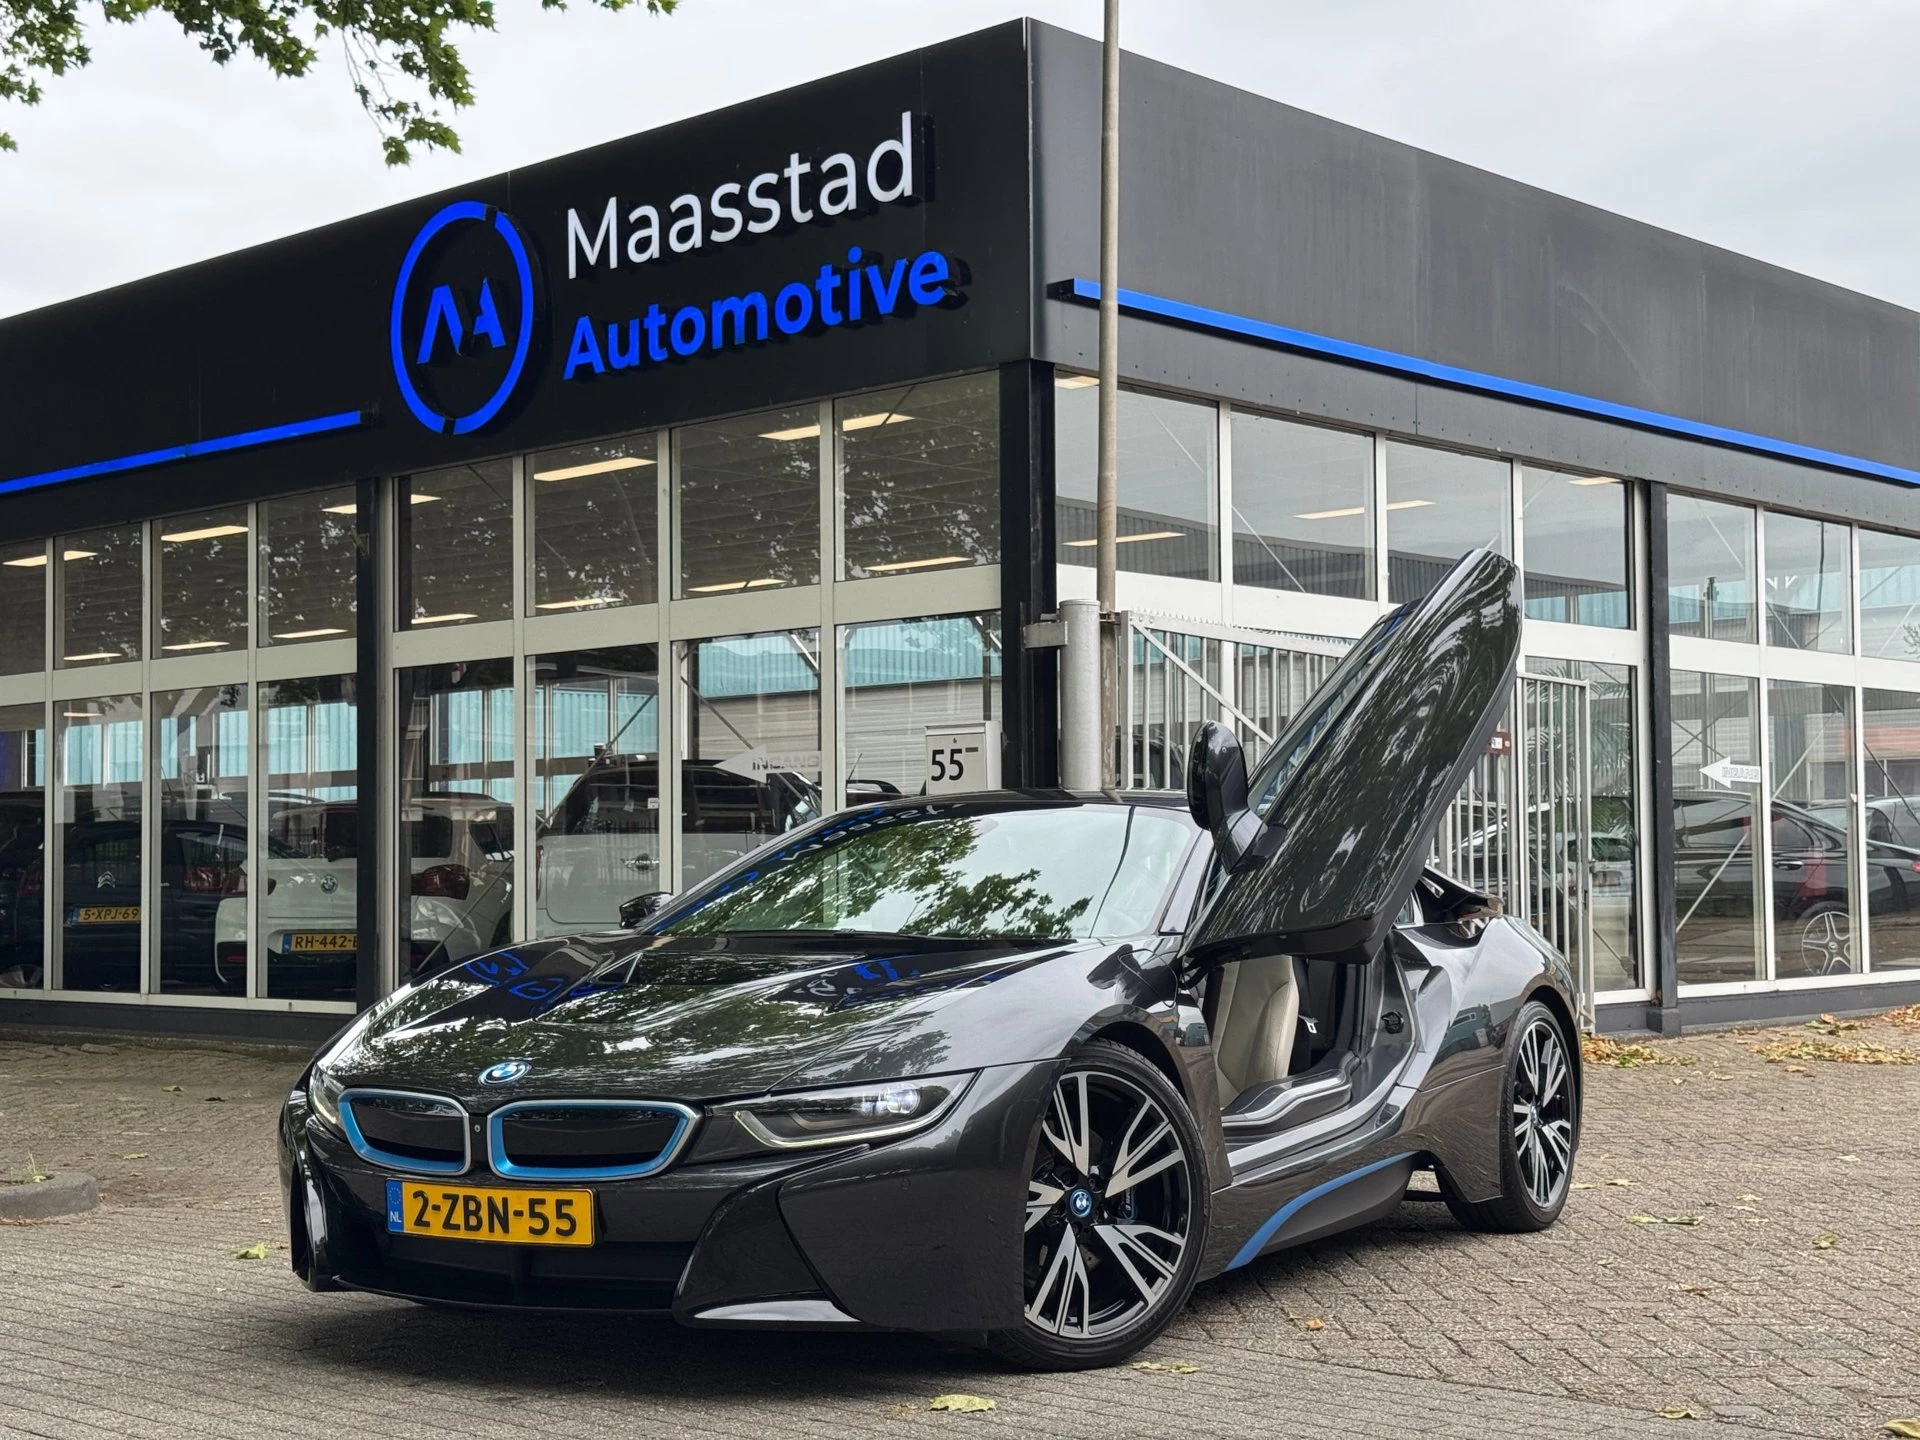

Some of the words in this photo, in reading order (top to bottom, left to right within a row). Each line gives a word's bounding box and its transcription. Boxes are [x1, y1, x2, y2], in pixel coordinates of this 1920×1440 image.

[567, 111, 913, 279] Maasstad
[562, 246, 950, 379] Automotive
[931, 748, 965, 782] 55
[82, 907, 140, 921] 5-XPJ-69
[390, 1210, 402, 1223] NL
[412, 1190, 577, 1237] 2-ZBN-55
